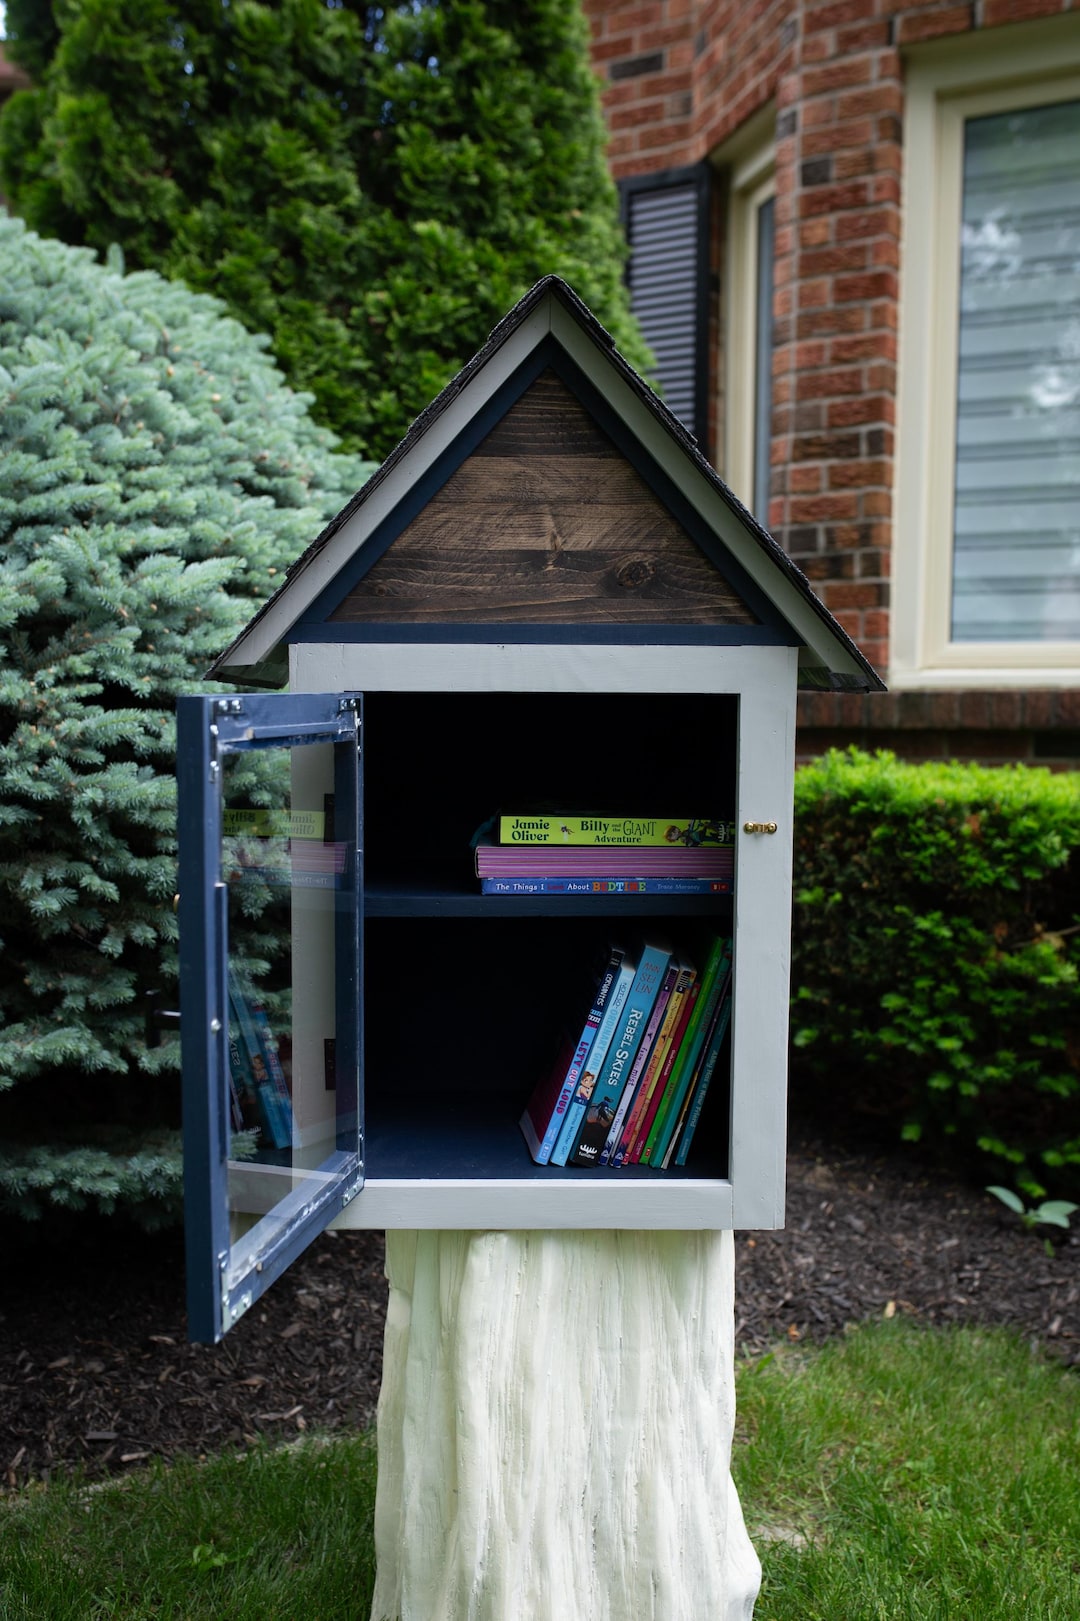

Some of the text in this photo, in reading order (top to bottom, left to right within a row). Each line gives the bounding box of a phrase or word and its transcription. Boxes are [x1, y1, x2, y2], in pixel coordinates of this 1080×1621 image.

[511, 819, 550, 830] Jamie
[580, 820, 610, 834] Billy
[622, 820, 656, 837] GIANT
[511, 830, 549, 841] Oliver
[594, 835, 642, 843] Adventure
[496, 883, 510, 891] The
[513, 883, 538, 893] Things
[541, 883, 545, 891] I
[567, 883, 590, 891] About
[592, 881, 647, 892] BEDTIME
[635, 982, 652, 995] LIN
[597, 1008, 617, 1051] ORDINARY
[608, 1008, 643, 1087] REBEL SKIES
[588, 1053, 602, 1071] GIRL
[706, 1050, 718, 1068] Abby
[556, 1041, 589, 1115] LETY OUT LOUD
[704, 1069, 713, 1082] Has
[697, 1089, 707, 1105] New
[690, 1106, 701, 1128] Friend
